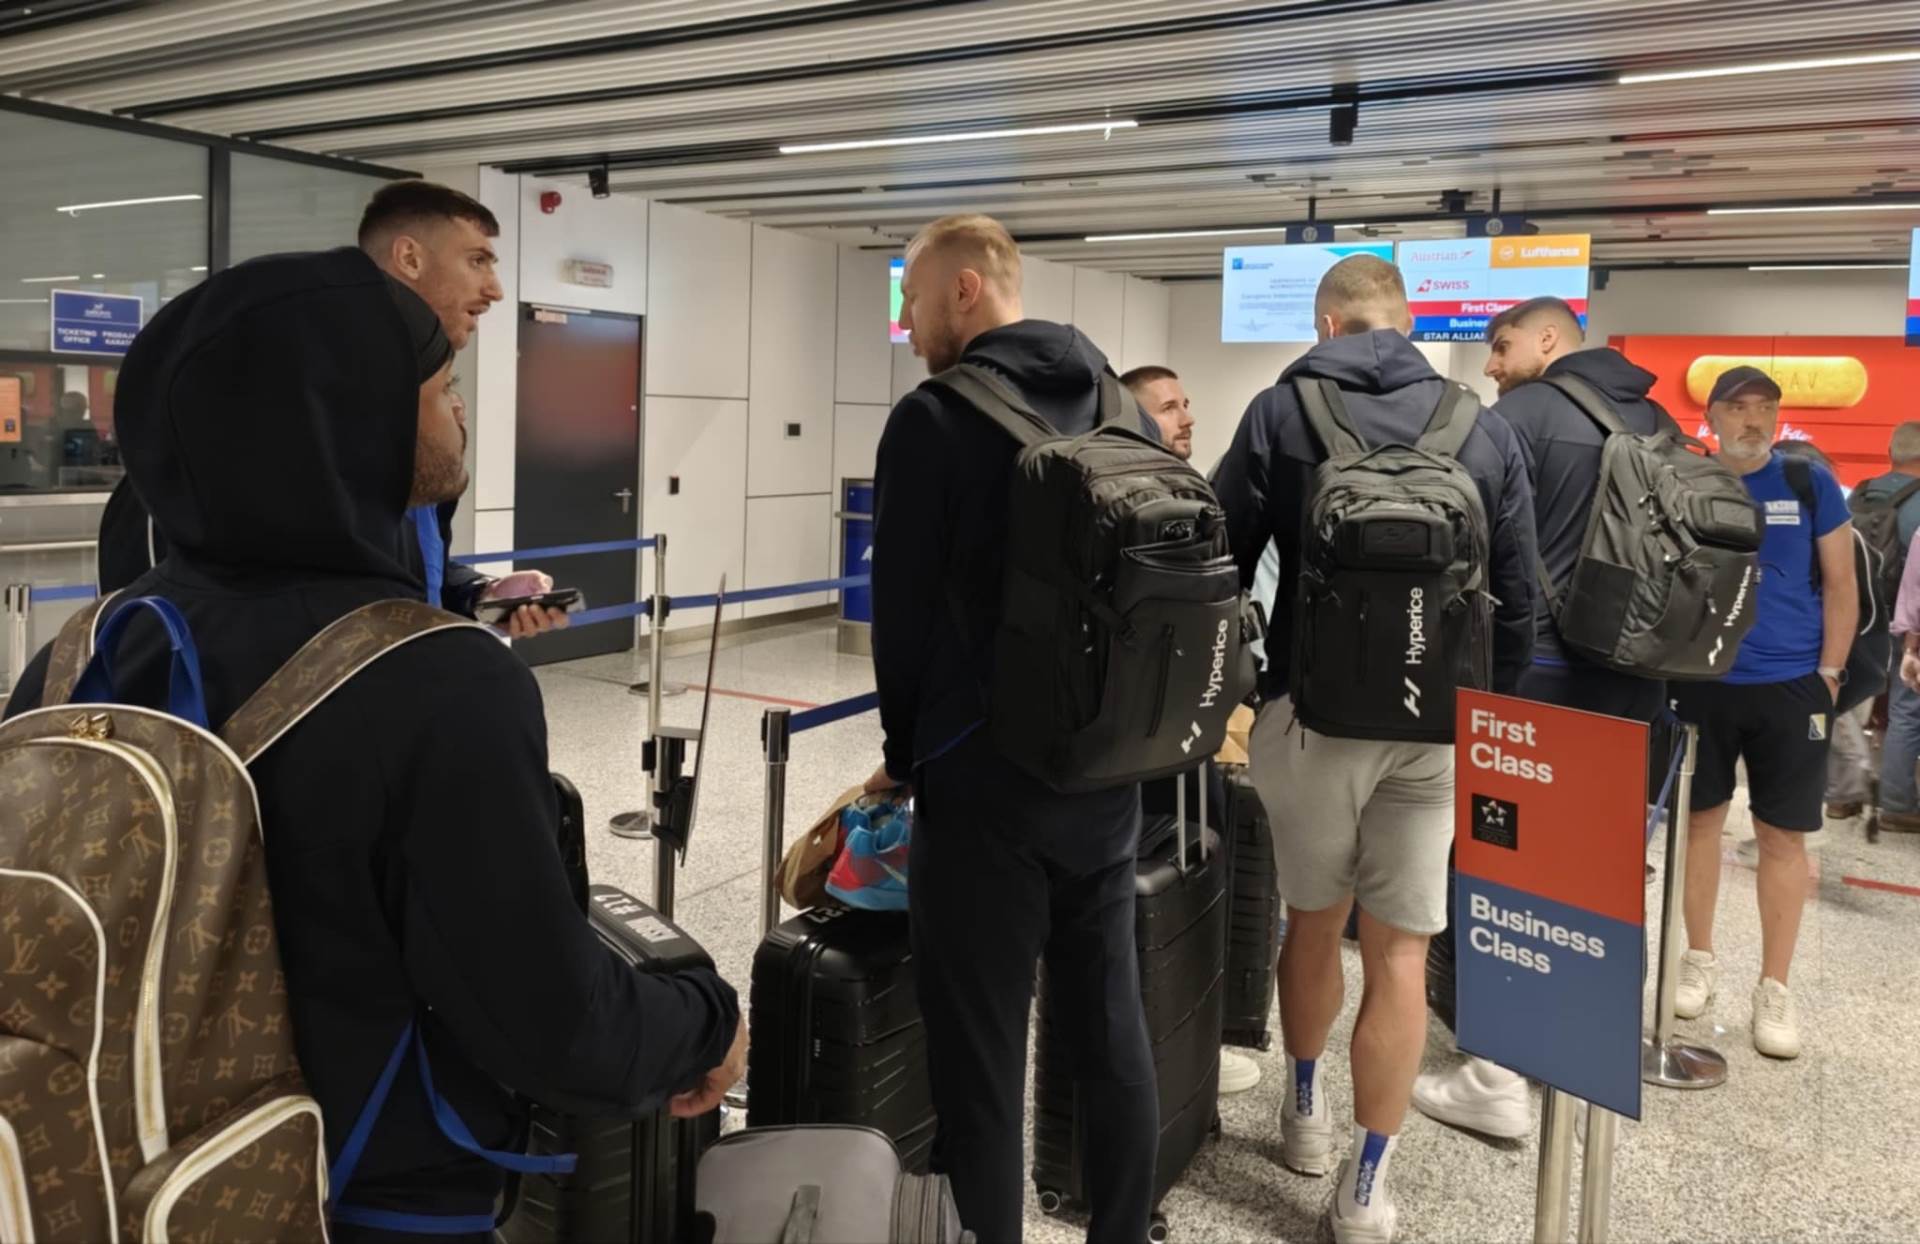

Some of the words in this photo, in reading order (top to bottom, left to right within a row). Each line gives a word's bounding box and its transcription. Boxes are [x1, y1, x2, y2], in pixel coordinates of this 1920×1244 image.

[1411, 251, 1458, 262] Austrian
[1520, 246, 1580, 259] Lufthansa
[1433, 280, 1470, 290] SWISS
[1461, 303, 1485, 313] First
[1450, 318, 1488, 328] Busines
[57, 328, 96, 337] TICKETING
[1423, 332, 1450, 341] STAR
[63, 335, 90, 344] OFFICE
[1723, 565, 1752, 627] Hyperice
[1405, 587, 1426, 664] Hyperice
[1200, 619, 1228, 708] Hyperice
[1470, 708, 1536, 747] First
[1470, 742, 1553, 784] Class
[1470, 892, 1605, 958] Business
[1469, 926, 1551, 974] Class
